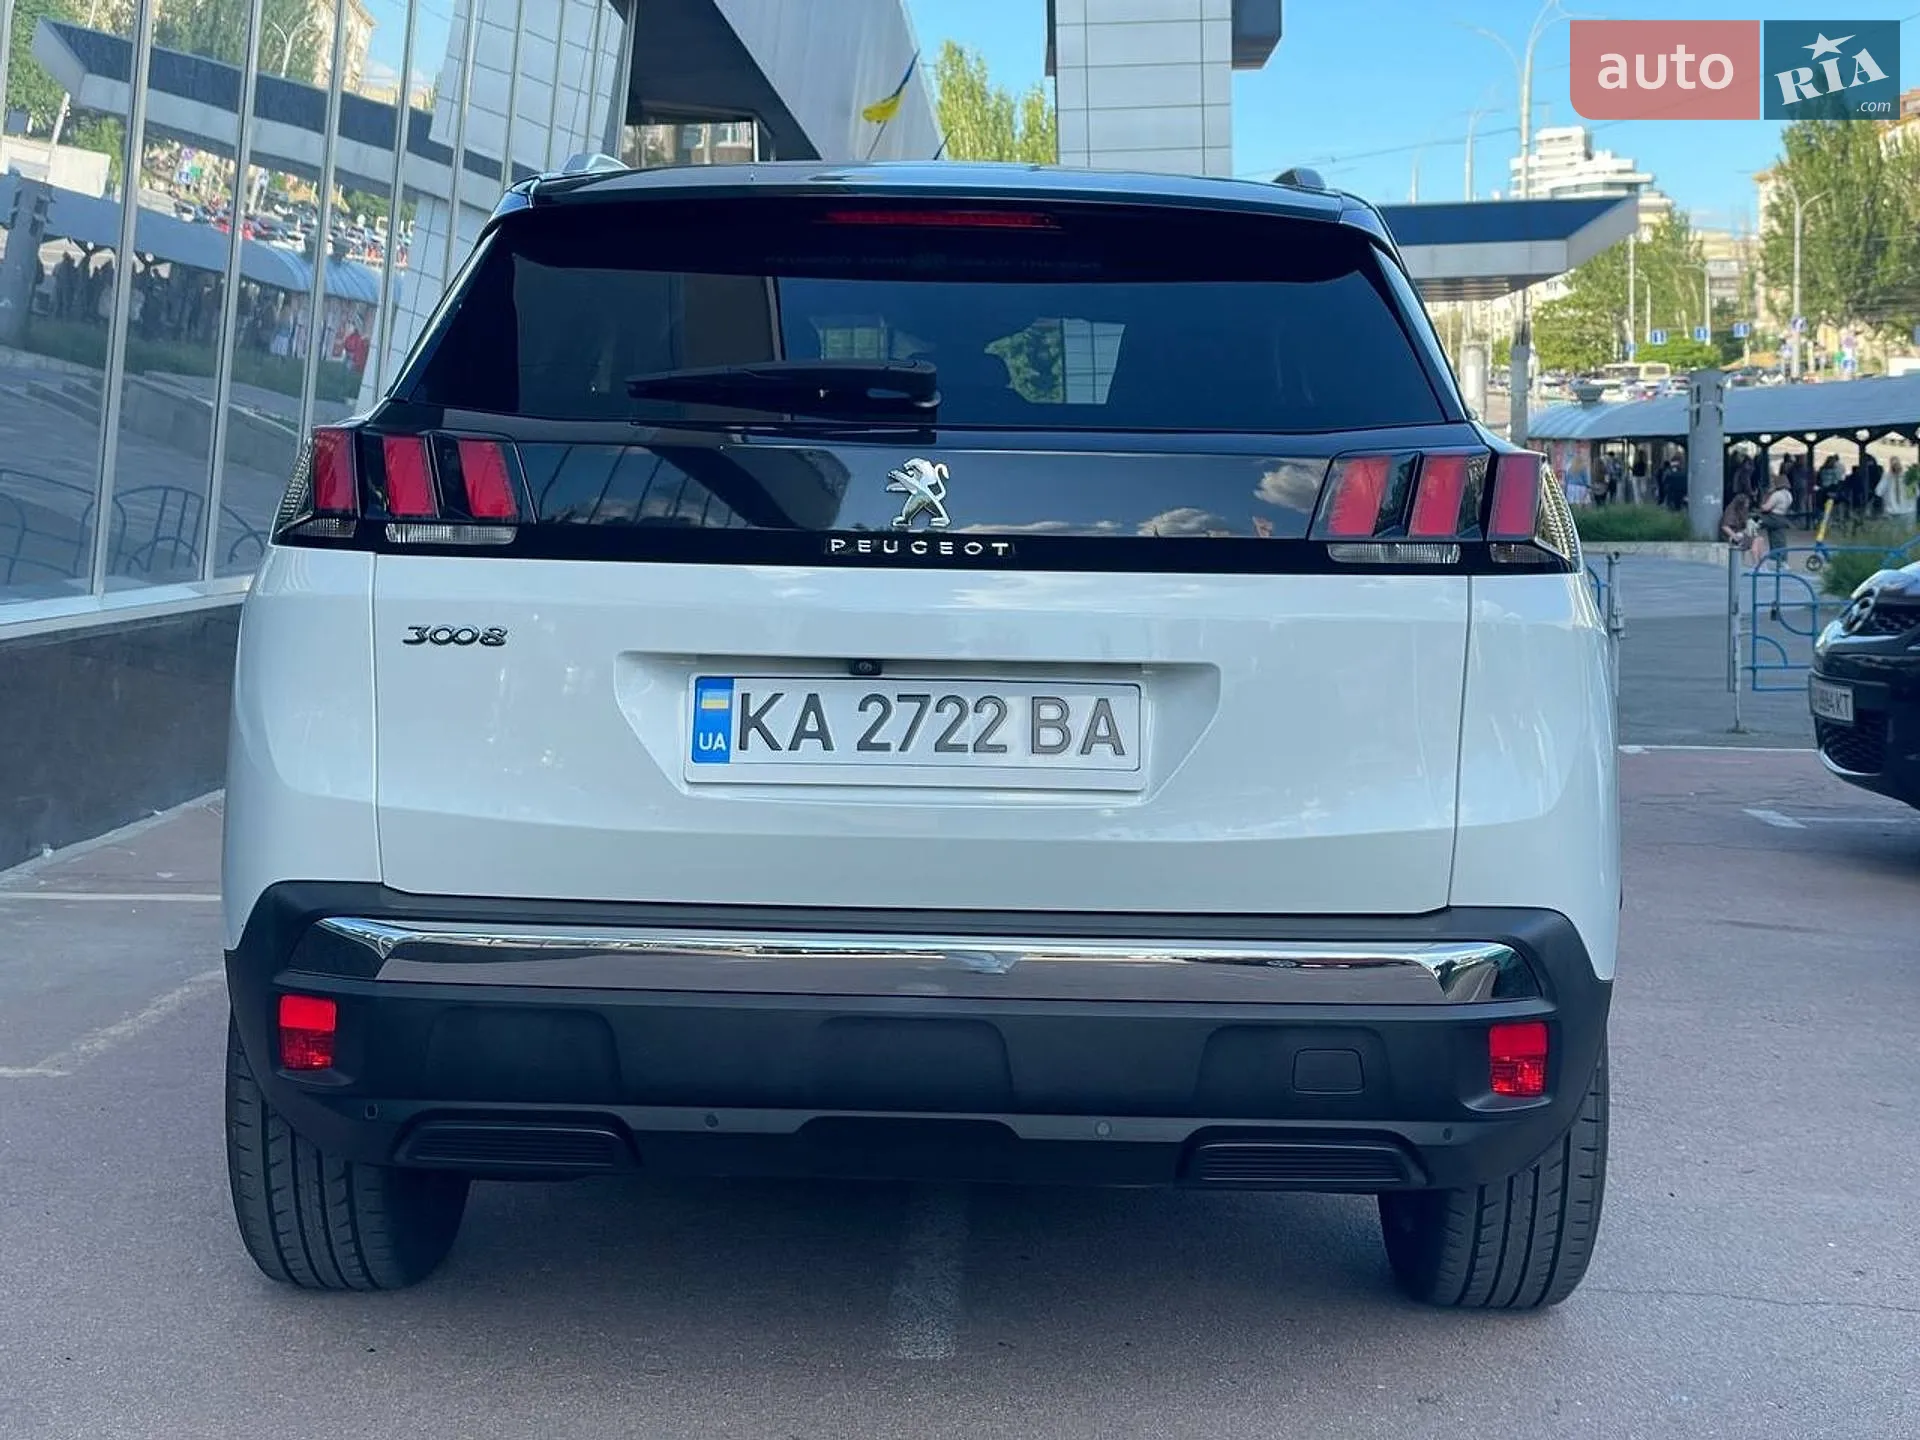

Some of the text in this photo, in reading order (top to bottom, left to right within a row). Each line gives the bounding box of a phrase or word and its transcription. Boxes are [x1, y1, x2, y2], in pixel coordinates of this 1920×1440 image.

[830, 538, 1009, 556] PEUGEOT
[402, 625, 508, 647] 3008
[738, 692, 1126, 756] KA 2722 BA
[699, 732, 727, 752] UA
